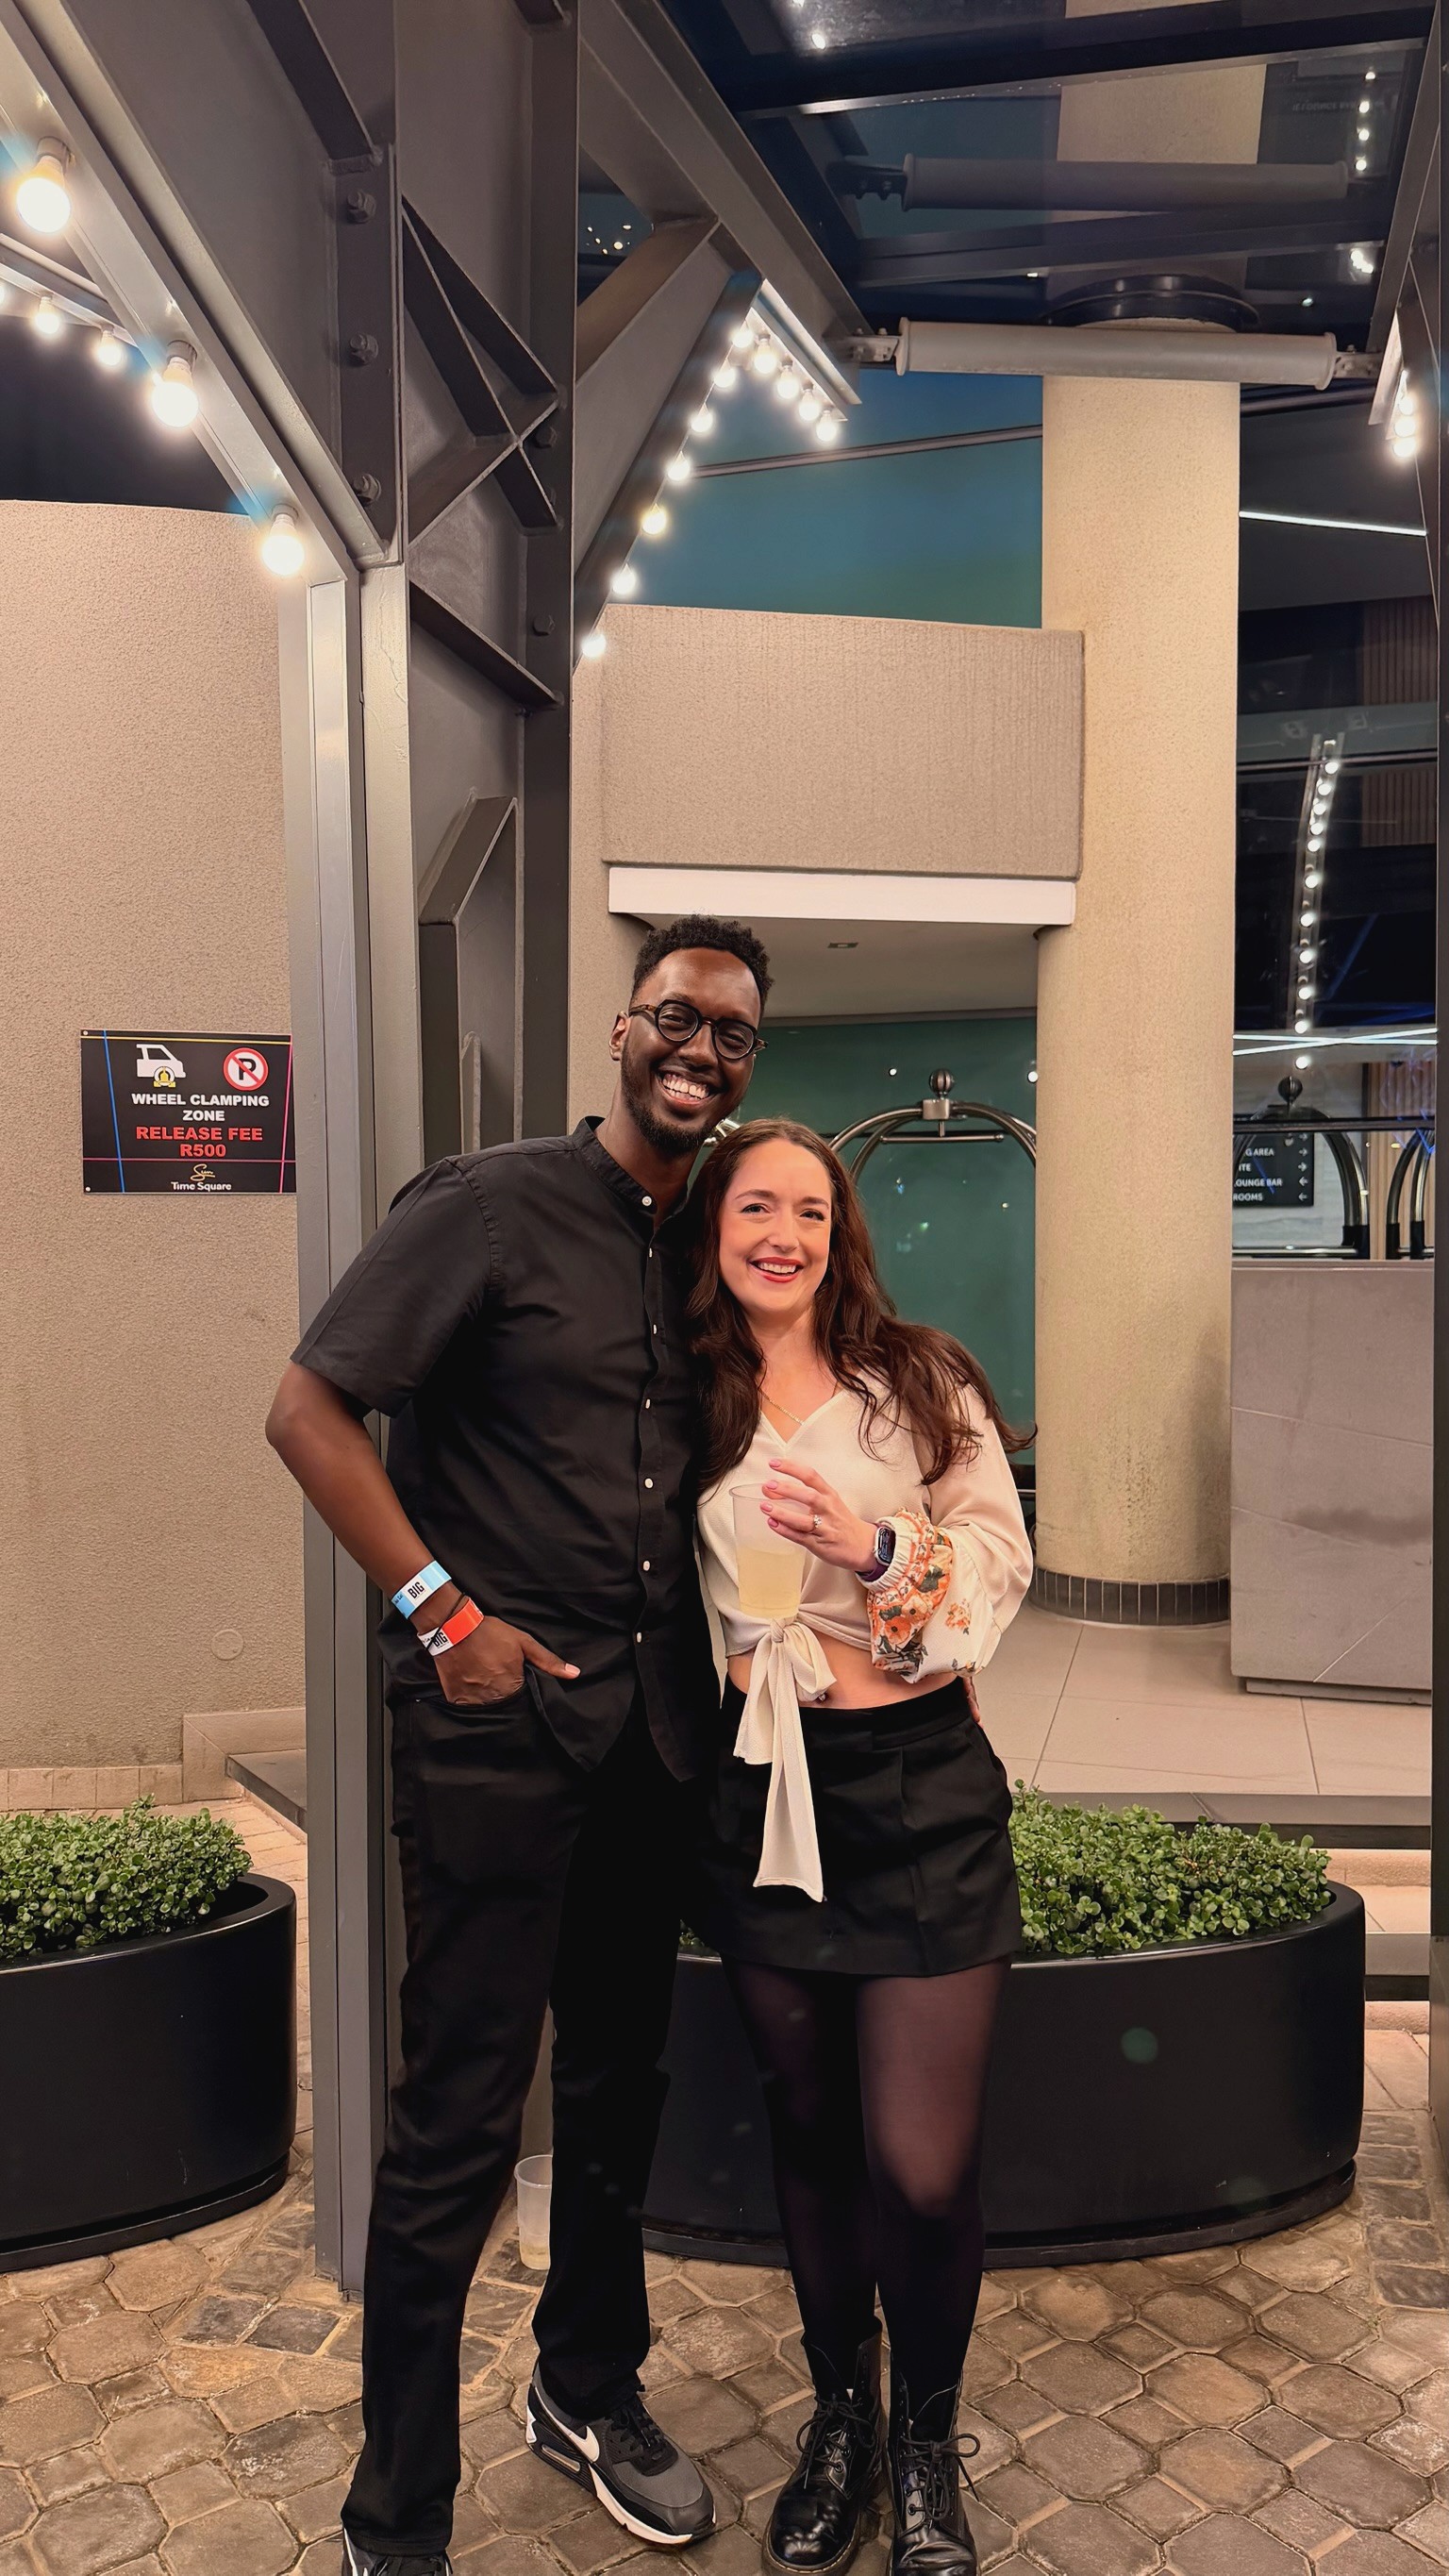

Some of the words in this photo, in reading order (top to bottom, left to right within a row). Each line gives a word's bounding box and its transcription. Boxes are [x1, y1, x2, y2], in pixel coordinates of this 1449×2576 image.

[131, 1094, 186, 1105] WHEEL
[190, 1094, 270, 1107] CLAMPING
[182, 1110, 225, 1121] ZONE
[136, 1127, 222, 1141] RELEASE
[227, 1128, 263, 1141] FEE
[179, 1144, 226, 1158] R500
[1253, 1147, 1274, 1157] AREA
[190, 1163, 216, 1181] Sun
[1239, 1163, 1251, 1171] ITE
[171, 1181, 195, 1191] Time
[197, 1181, 232, 1193] Square
[1234, 1178, 1265, 1188] OUNGE
[1266, 1178, 1283, 1187] BAR
[408, 1581, 425, 1599] BIG
[434, 1631, 448, 1648] BIG
